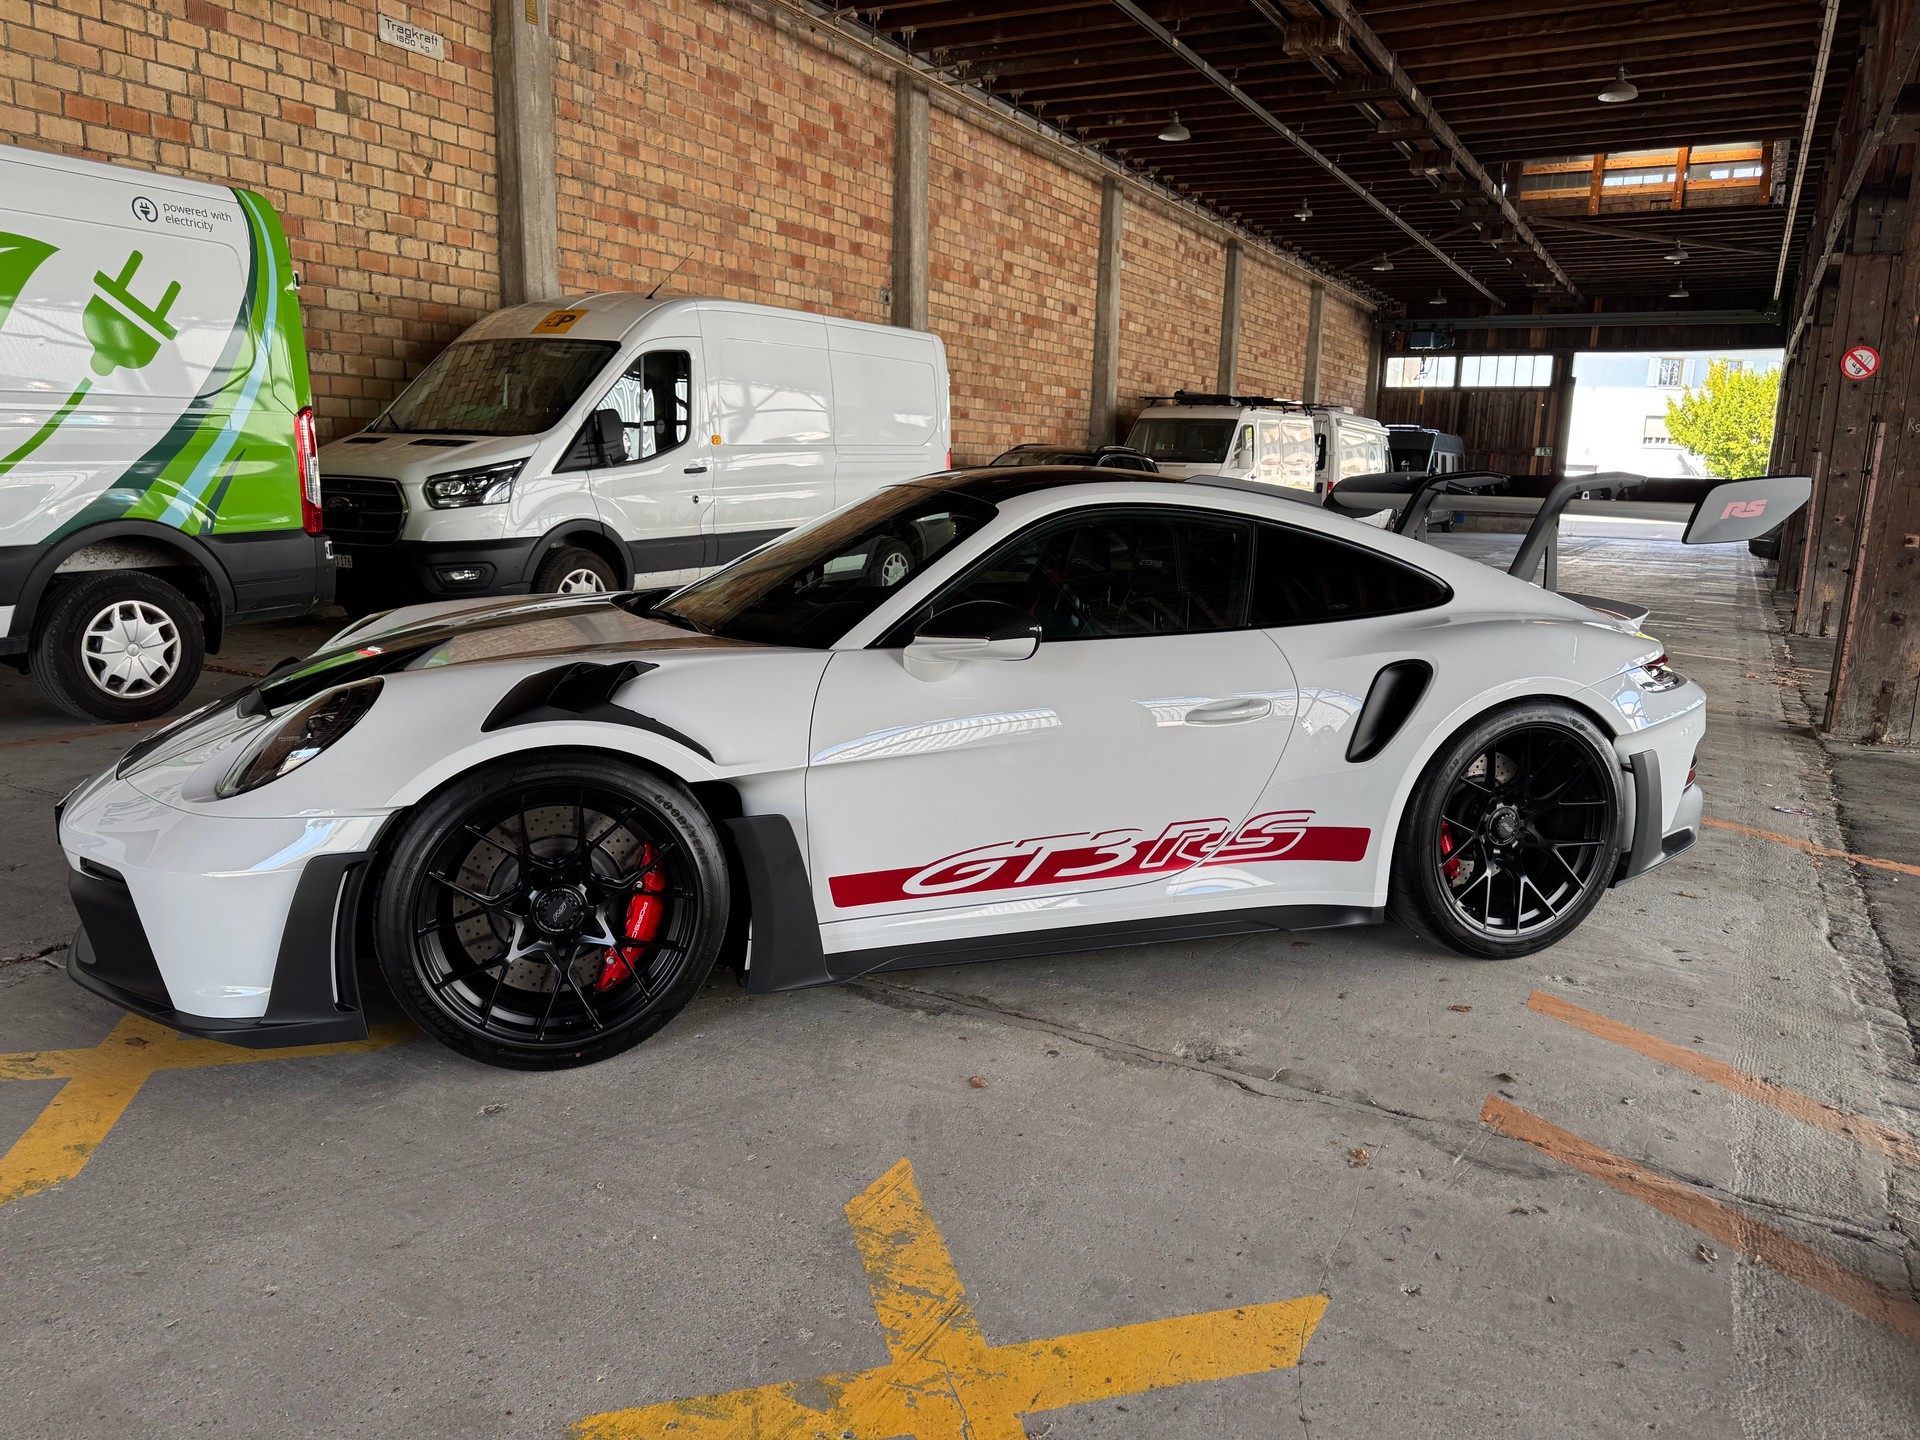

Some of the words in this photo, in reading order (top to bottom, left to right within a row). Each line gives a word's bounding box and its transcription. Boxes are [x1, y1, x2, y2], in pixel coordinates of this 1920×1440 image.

[385, 18, 438, 46] Tragkraft
[163, 203, 208, 217] powered
[211, 210, 232, 222] with
[165, 214, 214, 232] electricity
[1719, 499, 1768, 519] RS
